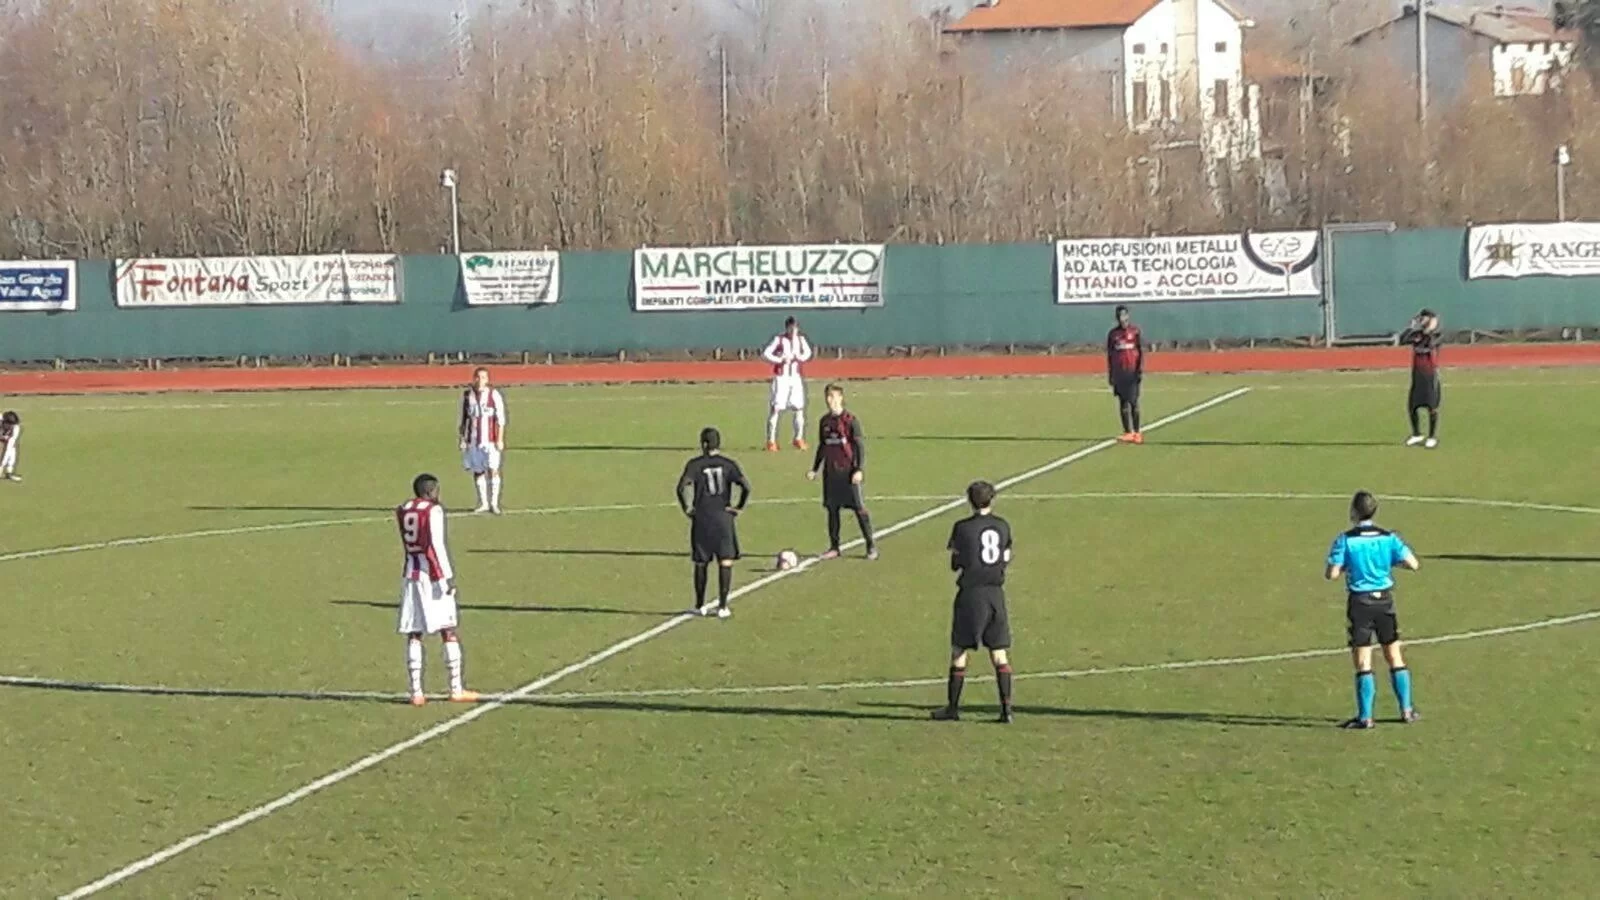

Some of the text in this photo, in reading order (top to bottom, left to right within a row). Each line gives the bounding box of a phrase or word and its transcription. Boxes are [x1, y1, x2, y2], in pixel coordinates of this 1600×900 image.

[1063, 239, 1237, 257] MICROFUSIONI METALLI
[640, 250, 879, 278] MARCHELUZZO
[1064, 256, 1237, 273] AD ALTA TECNOLOGIA
[134, 264, 309, 300] Fontana Sport
[706, 278, 814, 294] IMPIANTI
[1064, 274, 1138, 289] TITANIO
[1157, 272, 1238, 287] ACCIAIO
[703, 466, 724, 495] 11
[403, 511, 419, 543] 9
[981, 529, 1000, 564] 8
